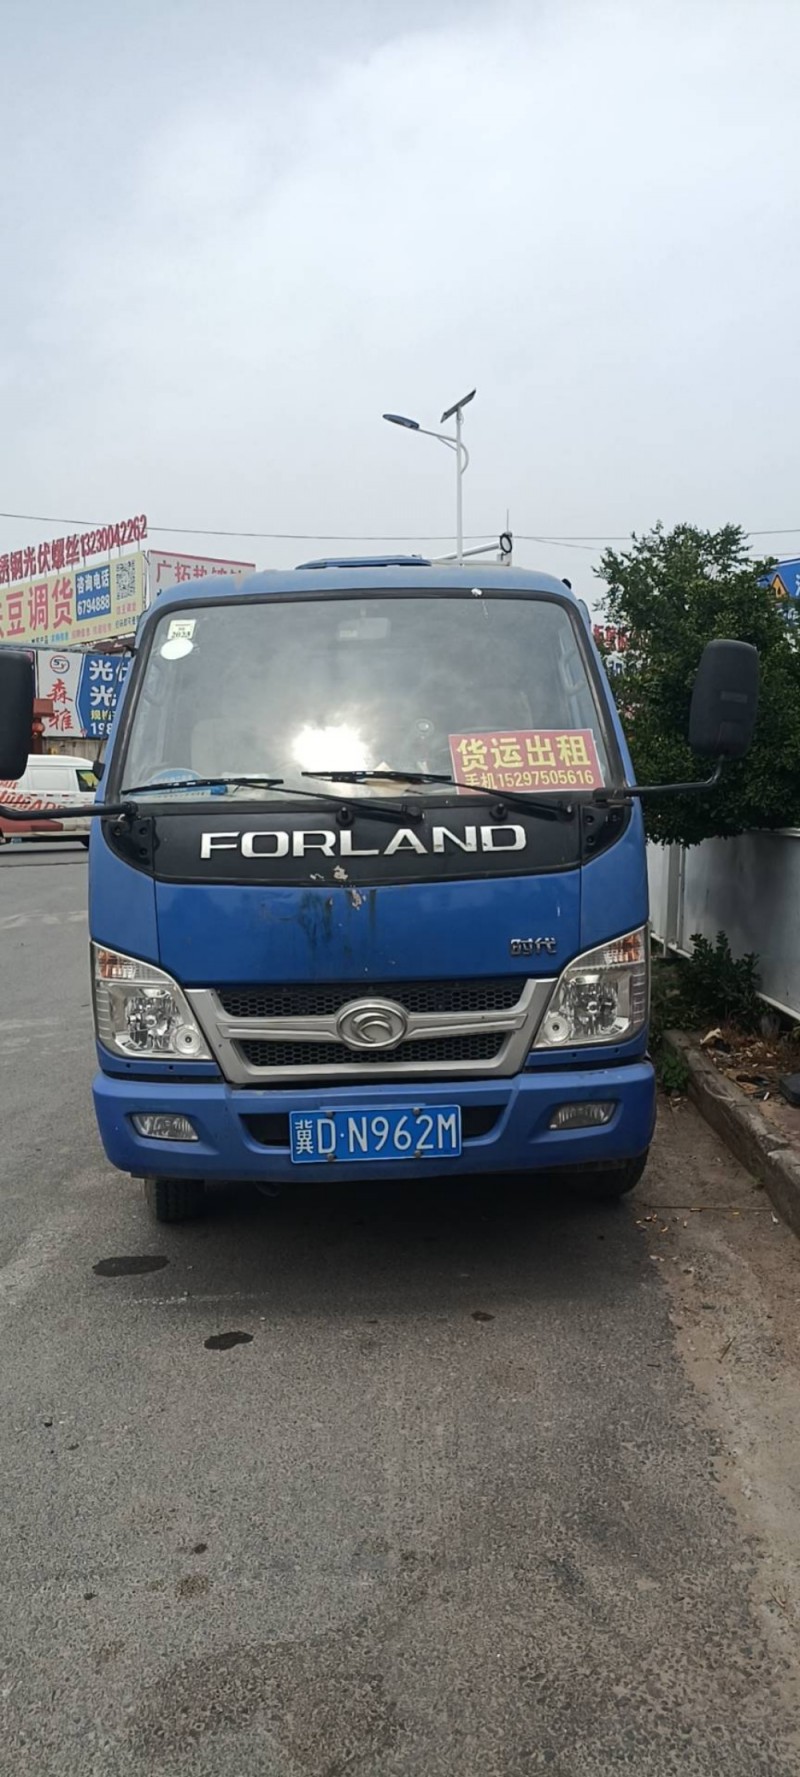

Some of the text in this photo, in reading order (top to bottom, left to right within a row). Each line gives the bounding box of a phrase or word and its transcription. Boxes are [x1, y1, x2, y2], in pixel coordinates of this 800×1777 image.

[76, 569, 110, 594] 咨询电话
[0, 577, 73, 638] 豆调货
[77, 595, 110, 616] 6794888
[457, 735, 591, 772] 货运出租
[200, 825, 527, 858] FORLAND
[511, 937, 557, 955] 时代
